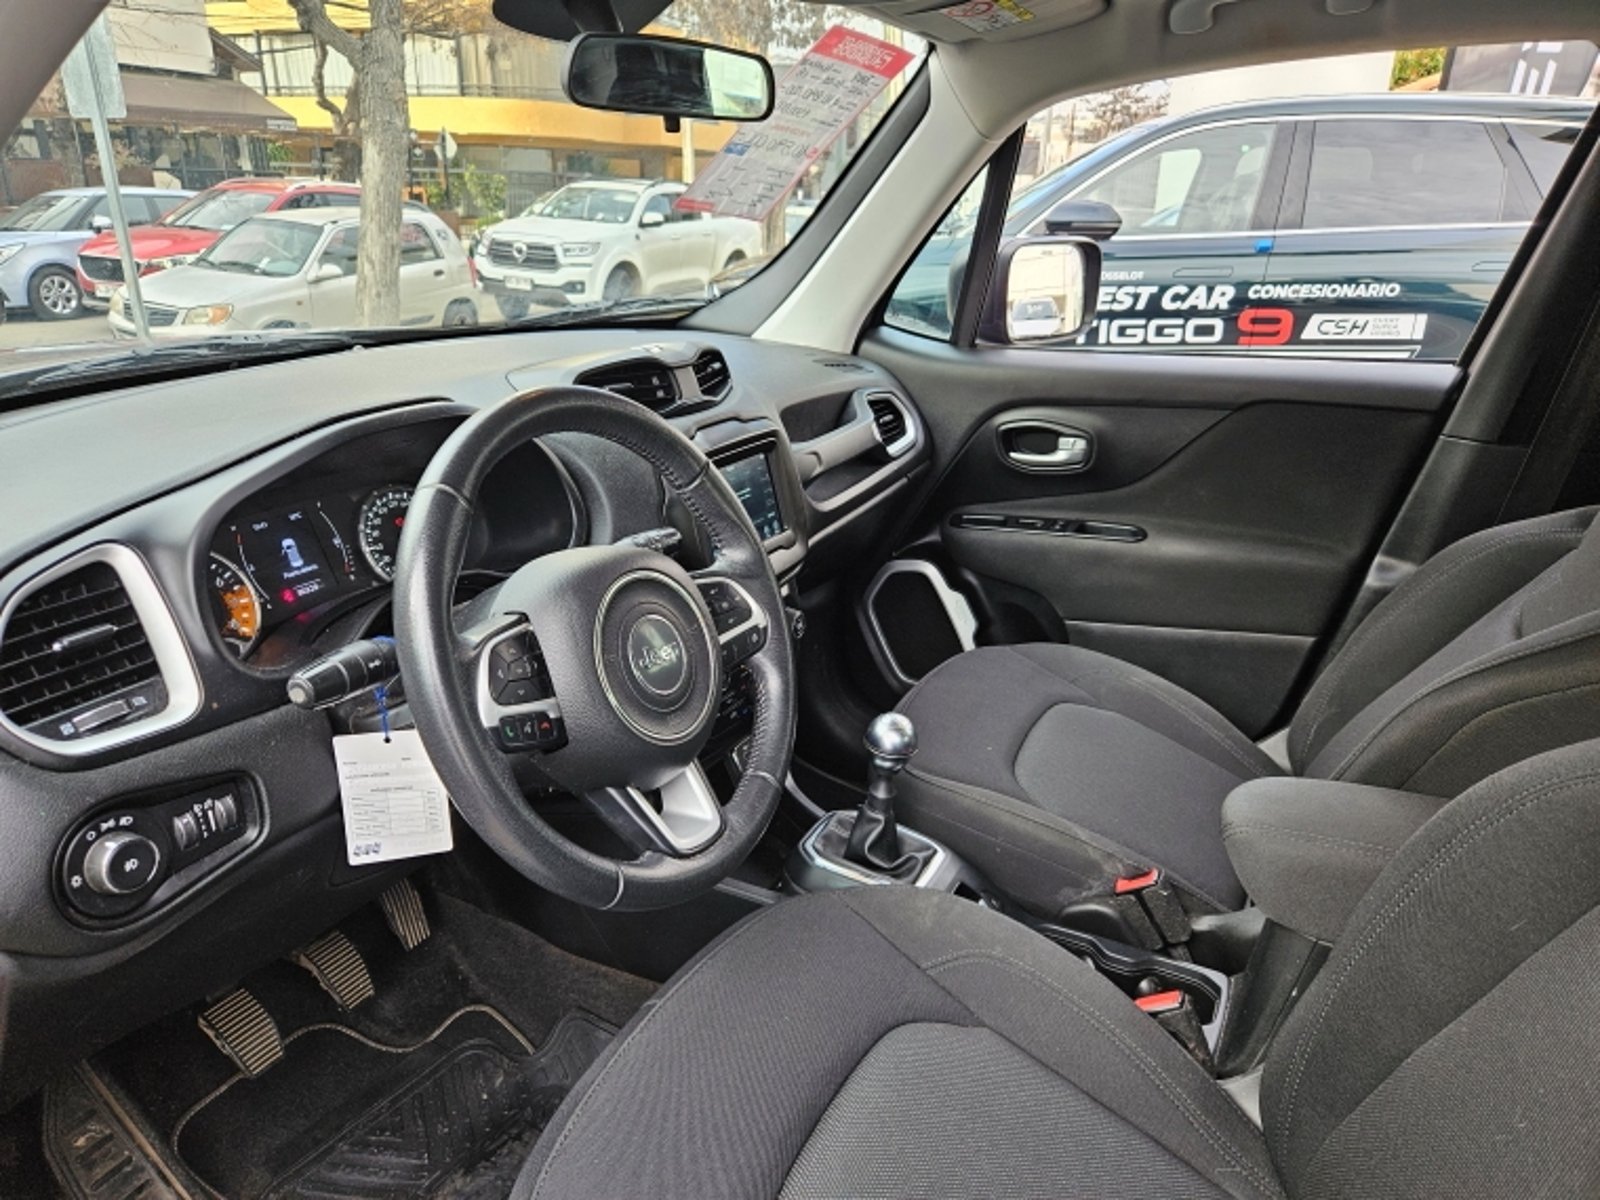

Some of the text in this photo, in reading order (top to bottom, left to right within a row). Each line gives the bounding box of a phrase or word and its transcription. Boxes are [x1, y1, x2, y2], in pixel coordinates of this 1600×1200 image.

[1101, 271, 1144, 281] OSSELOT
[1096, 284, 1236, 311] EST CAR
[1248, 283, 1401, 300] CONCESIONARIO
[1237, 306, 1294, 346] 9
[1317, 319, 1370, 336] CSH
